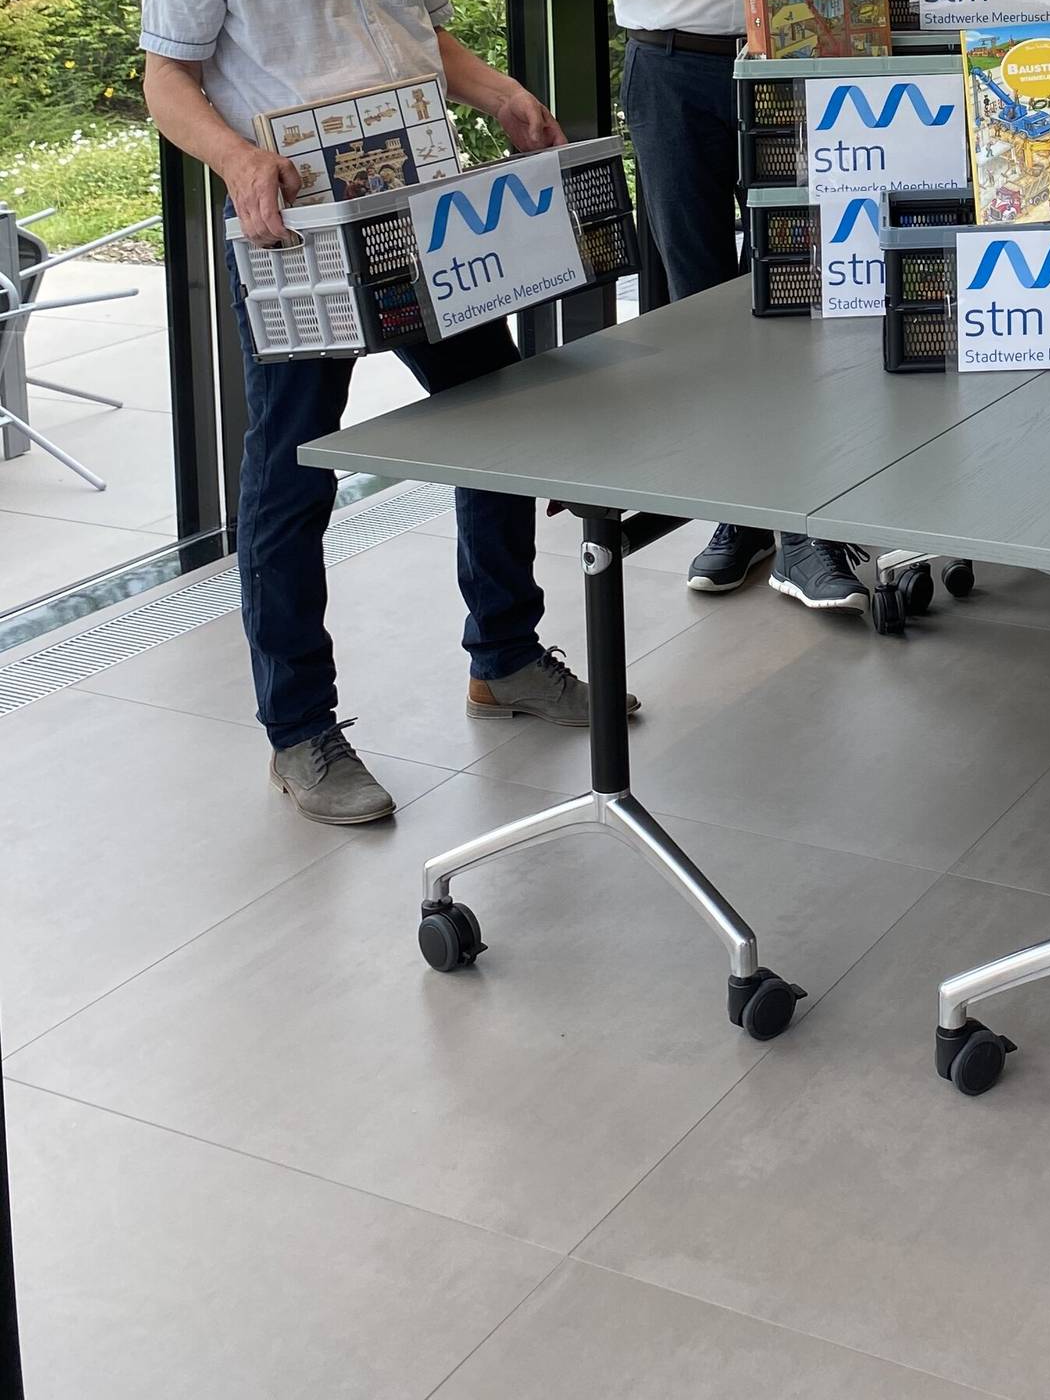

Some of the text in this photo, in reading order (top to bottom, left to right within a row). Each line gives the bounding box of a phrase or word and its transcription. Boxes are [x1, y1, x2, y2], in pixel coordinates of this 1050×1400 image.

[925, 12, 989, 24] Stadtwerke
[814, 140, 885, 173] stm
[432, 252, 504, 300] stm
[443, 268, 576, 328] Stadtwerke Meerbusch
[829, 297, 886, 310] Stadtwer
[965, 301, 1043, 337] stm
[965, 349, 1044, 363] Stadtwerke
